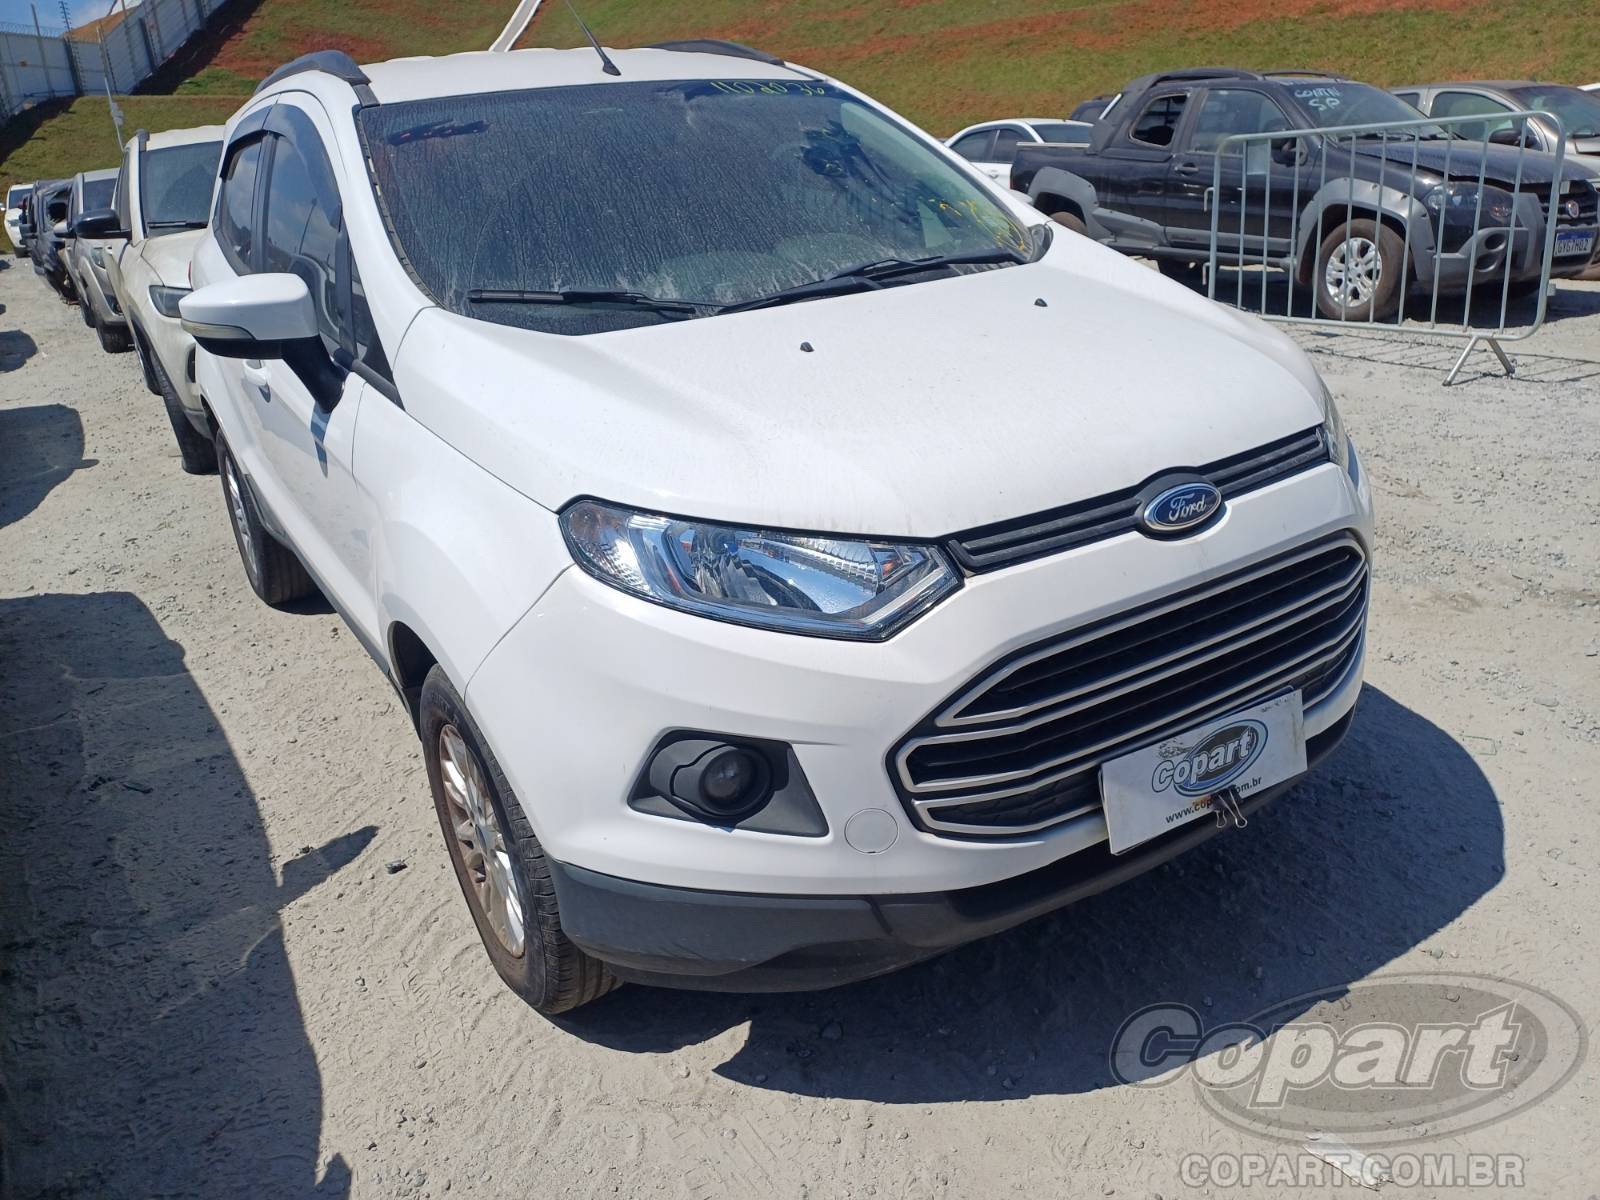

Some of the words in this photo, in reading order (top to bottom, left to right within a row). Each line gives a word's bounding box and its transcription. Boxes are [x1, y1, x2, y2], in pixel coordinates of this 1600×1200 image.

[1168, 493, 1207, 522] Ford
[1152, 727, 1255, 793] Copart
[1165, 776, 1263, 824] www.copom.br
